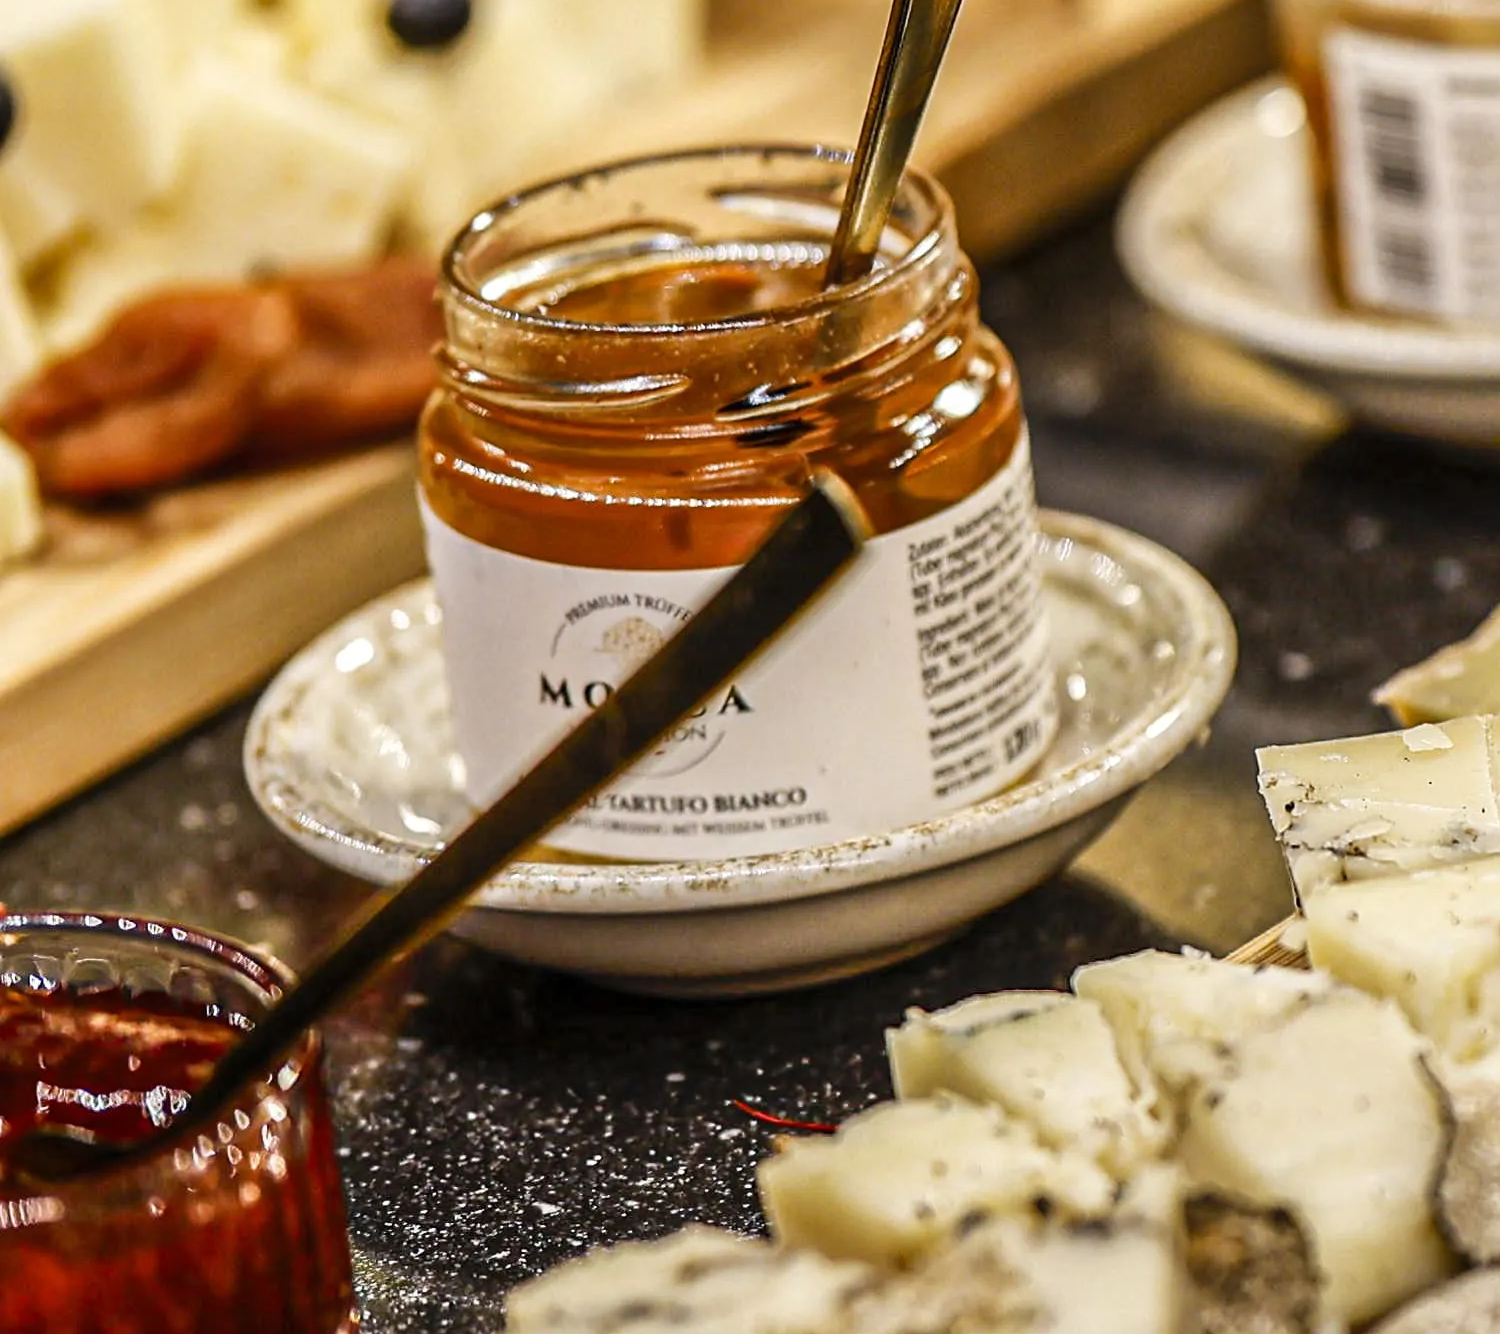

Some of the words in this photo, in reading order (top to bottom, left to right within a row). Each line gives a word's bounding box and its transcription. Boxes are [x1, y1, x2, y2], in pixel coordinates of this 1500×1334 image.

[565, 593, 631, 625] PREMIUM
[634, 593, 693, 622] TRÜFFE
[608, 793, 708, 815] TARTUFO
[714, 786, 808, 813] BIANCO
